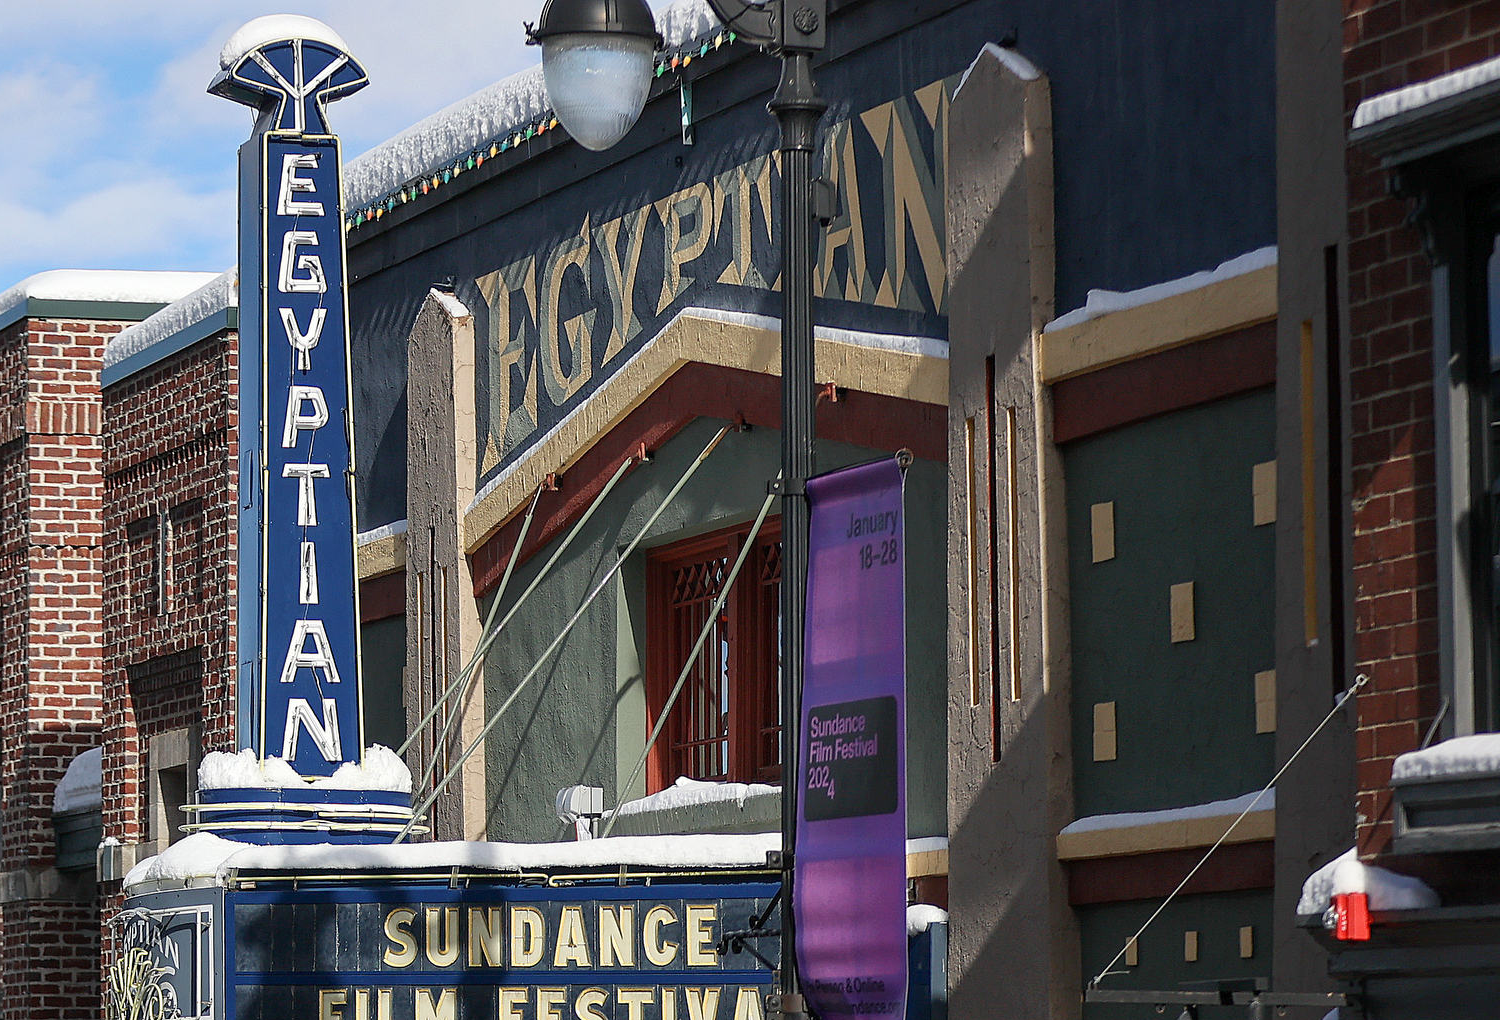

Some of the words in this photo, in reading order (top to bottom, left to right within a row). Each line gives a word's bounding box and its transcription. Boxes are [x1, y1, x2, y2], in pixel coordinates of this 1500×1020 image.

[474, 79, 949, 480] EGYPTAN
[276, 153, 343, 765] EGYPTIAN
[846, 510, 898, 539] January
[810, 712, 866, 738] Sundance
[809, 740, 833, 764] Film
[835, 733, 878, 760] Festival
[808, 765, 836, 800] 2024
[383, 904, 719, 968] SUNDANCE
